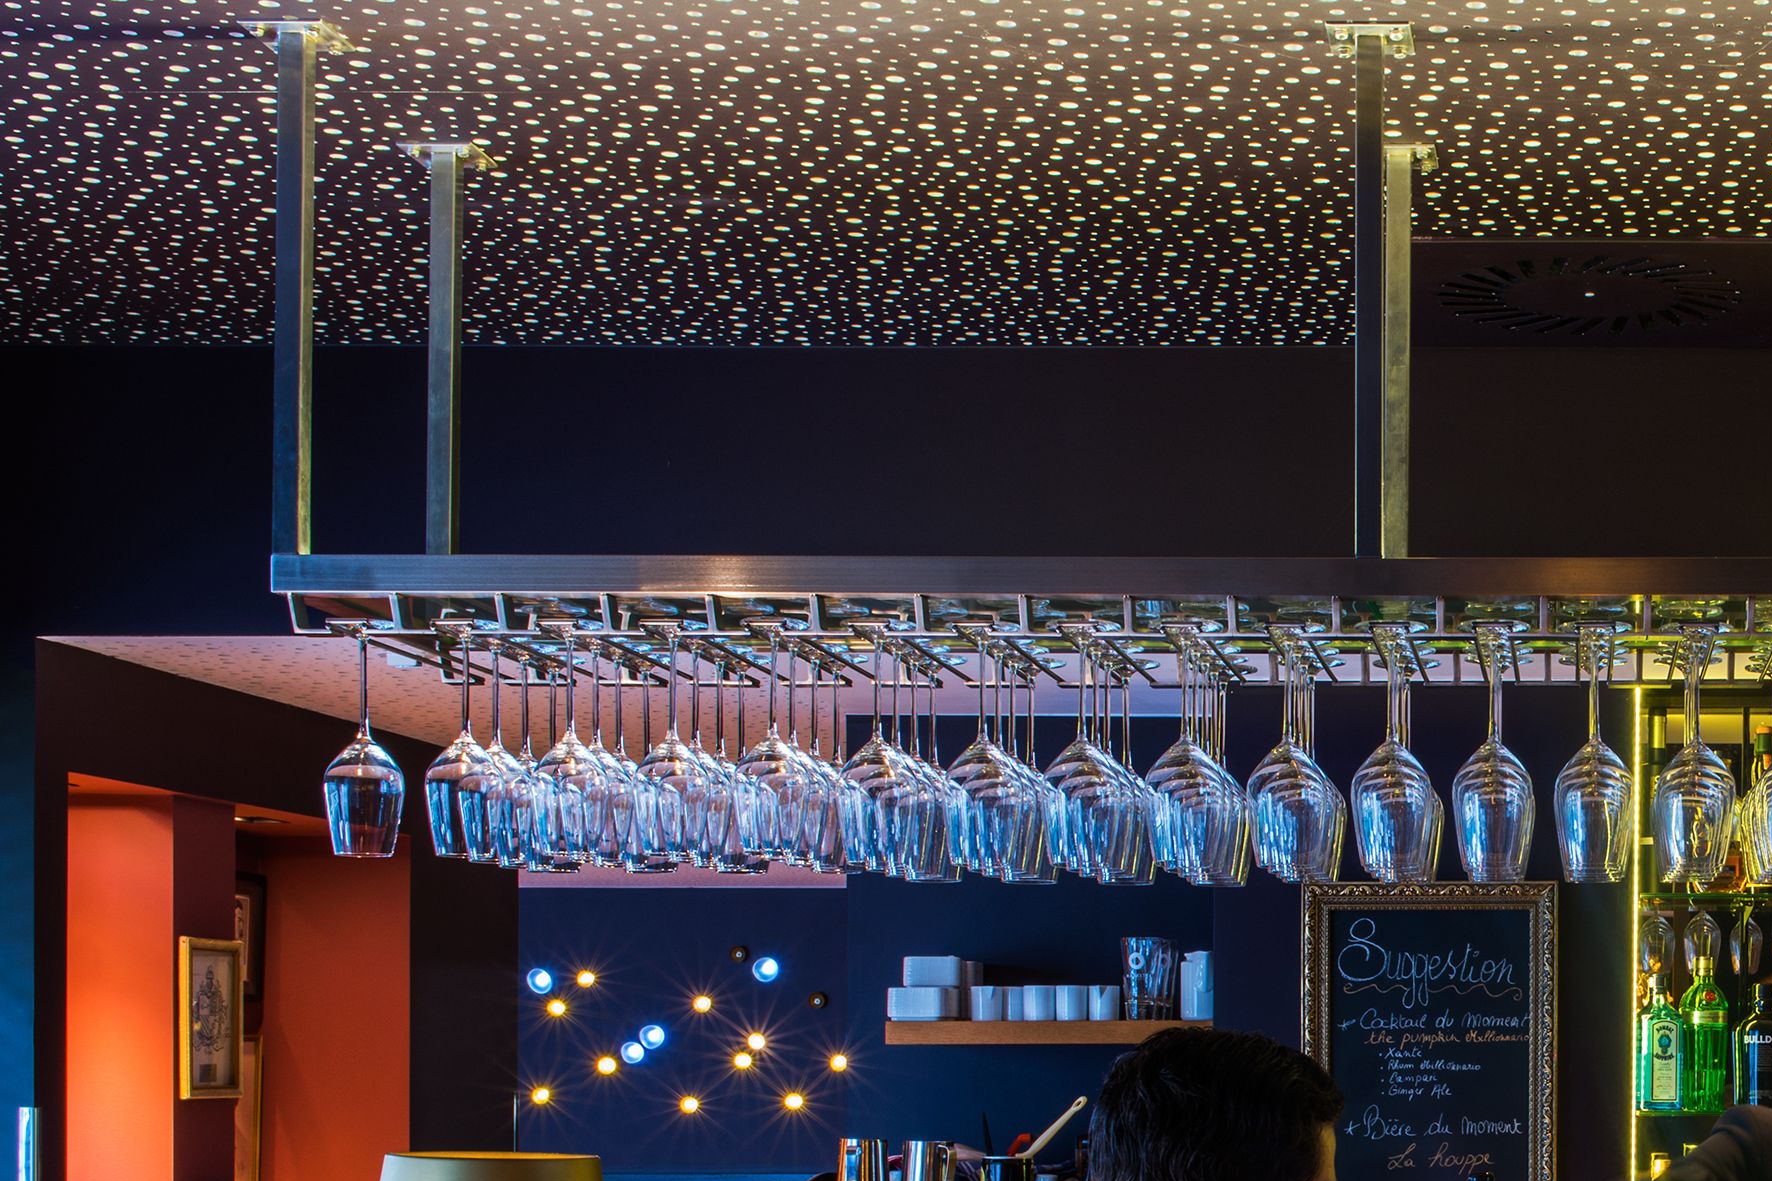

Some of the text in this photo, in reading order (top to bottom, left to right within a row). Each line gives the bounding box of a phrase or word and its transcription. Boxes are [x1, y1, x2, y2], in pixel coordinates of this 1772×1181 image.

[1338, 918, 1515, 1008] Suggestion
[1360, 1008, 1426, 1030] Cocktail
[1435, 1008, 1454, 1029] du
[1364, 1031, 1395, 1044] the
[1400, 1031, 1461, 1049] pumpkin
[1389, 1072, 1438, 1086] Campari
[1388, 1084, 1452, 1101] Ginger Ale
[1424, 1113, 1453, 1134] du
[1388, 1142, 1416, 1170] La
